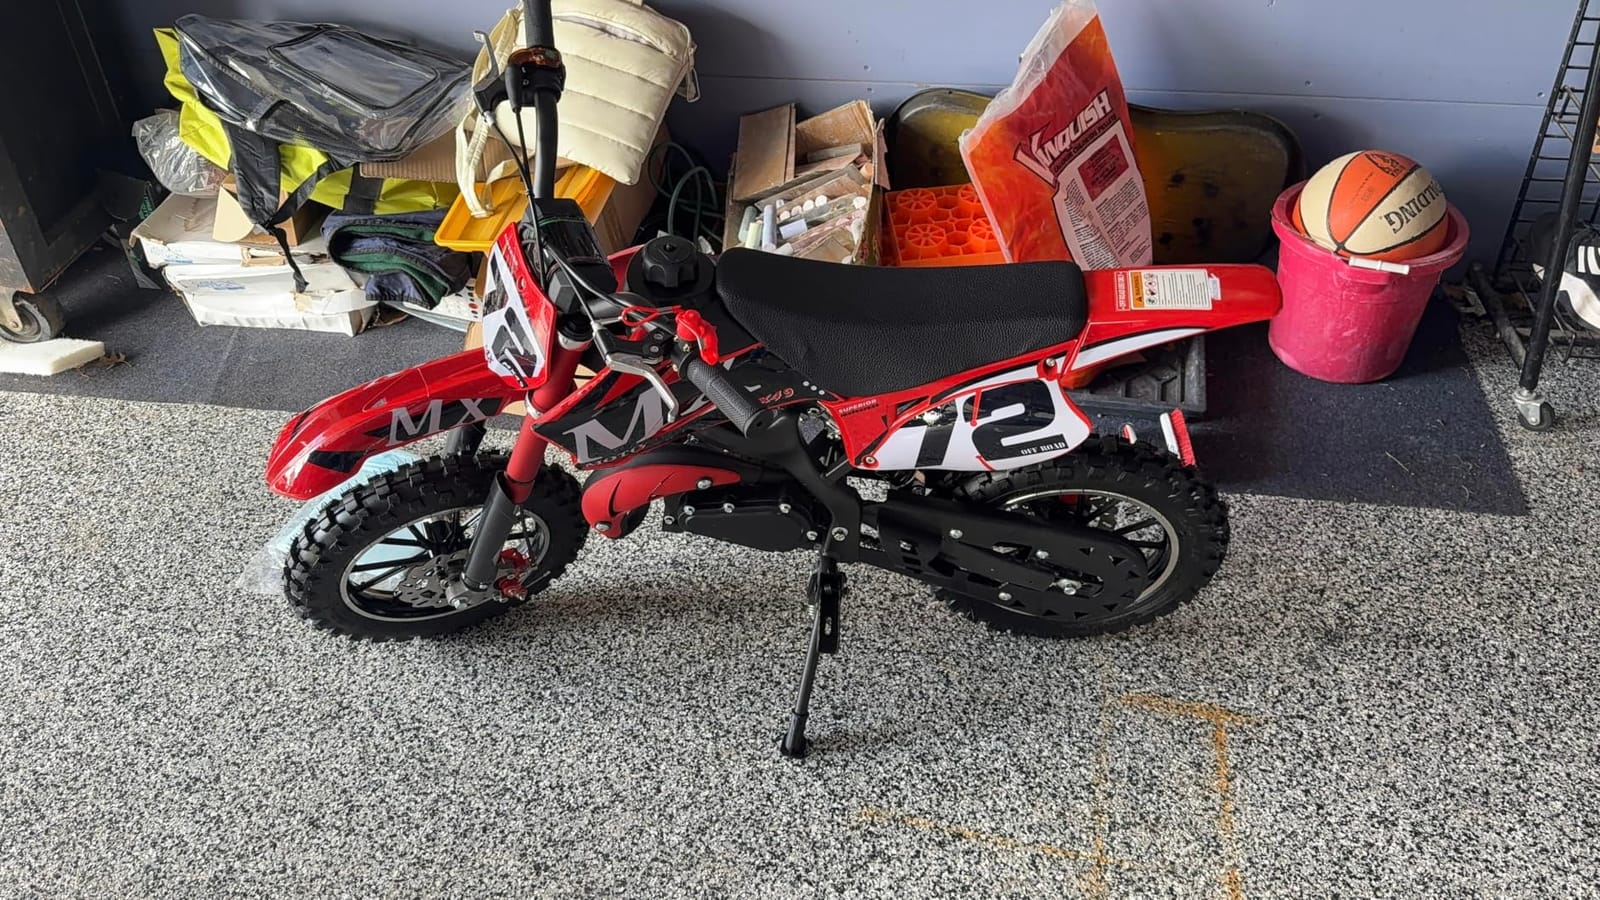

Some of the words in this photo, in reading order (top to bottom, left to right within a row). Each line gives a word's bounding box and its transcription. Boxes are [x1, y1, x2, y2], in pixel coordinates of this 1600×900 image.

[1014, 88, 1113, 186] VANQUISH
[387, 397, 488, 447] MX
[838, 398, 877, 414] SUPERIOR
[1020, 446, 1037, 455] OFF
[1039, 441, 1066, 452] ROAD
